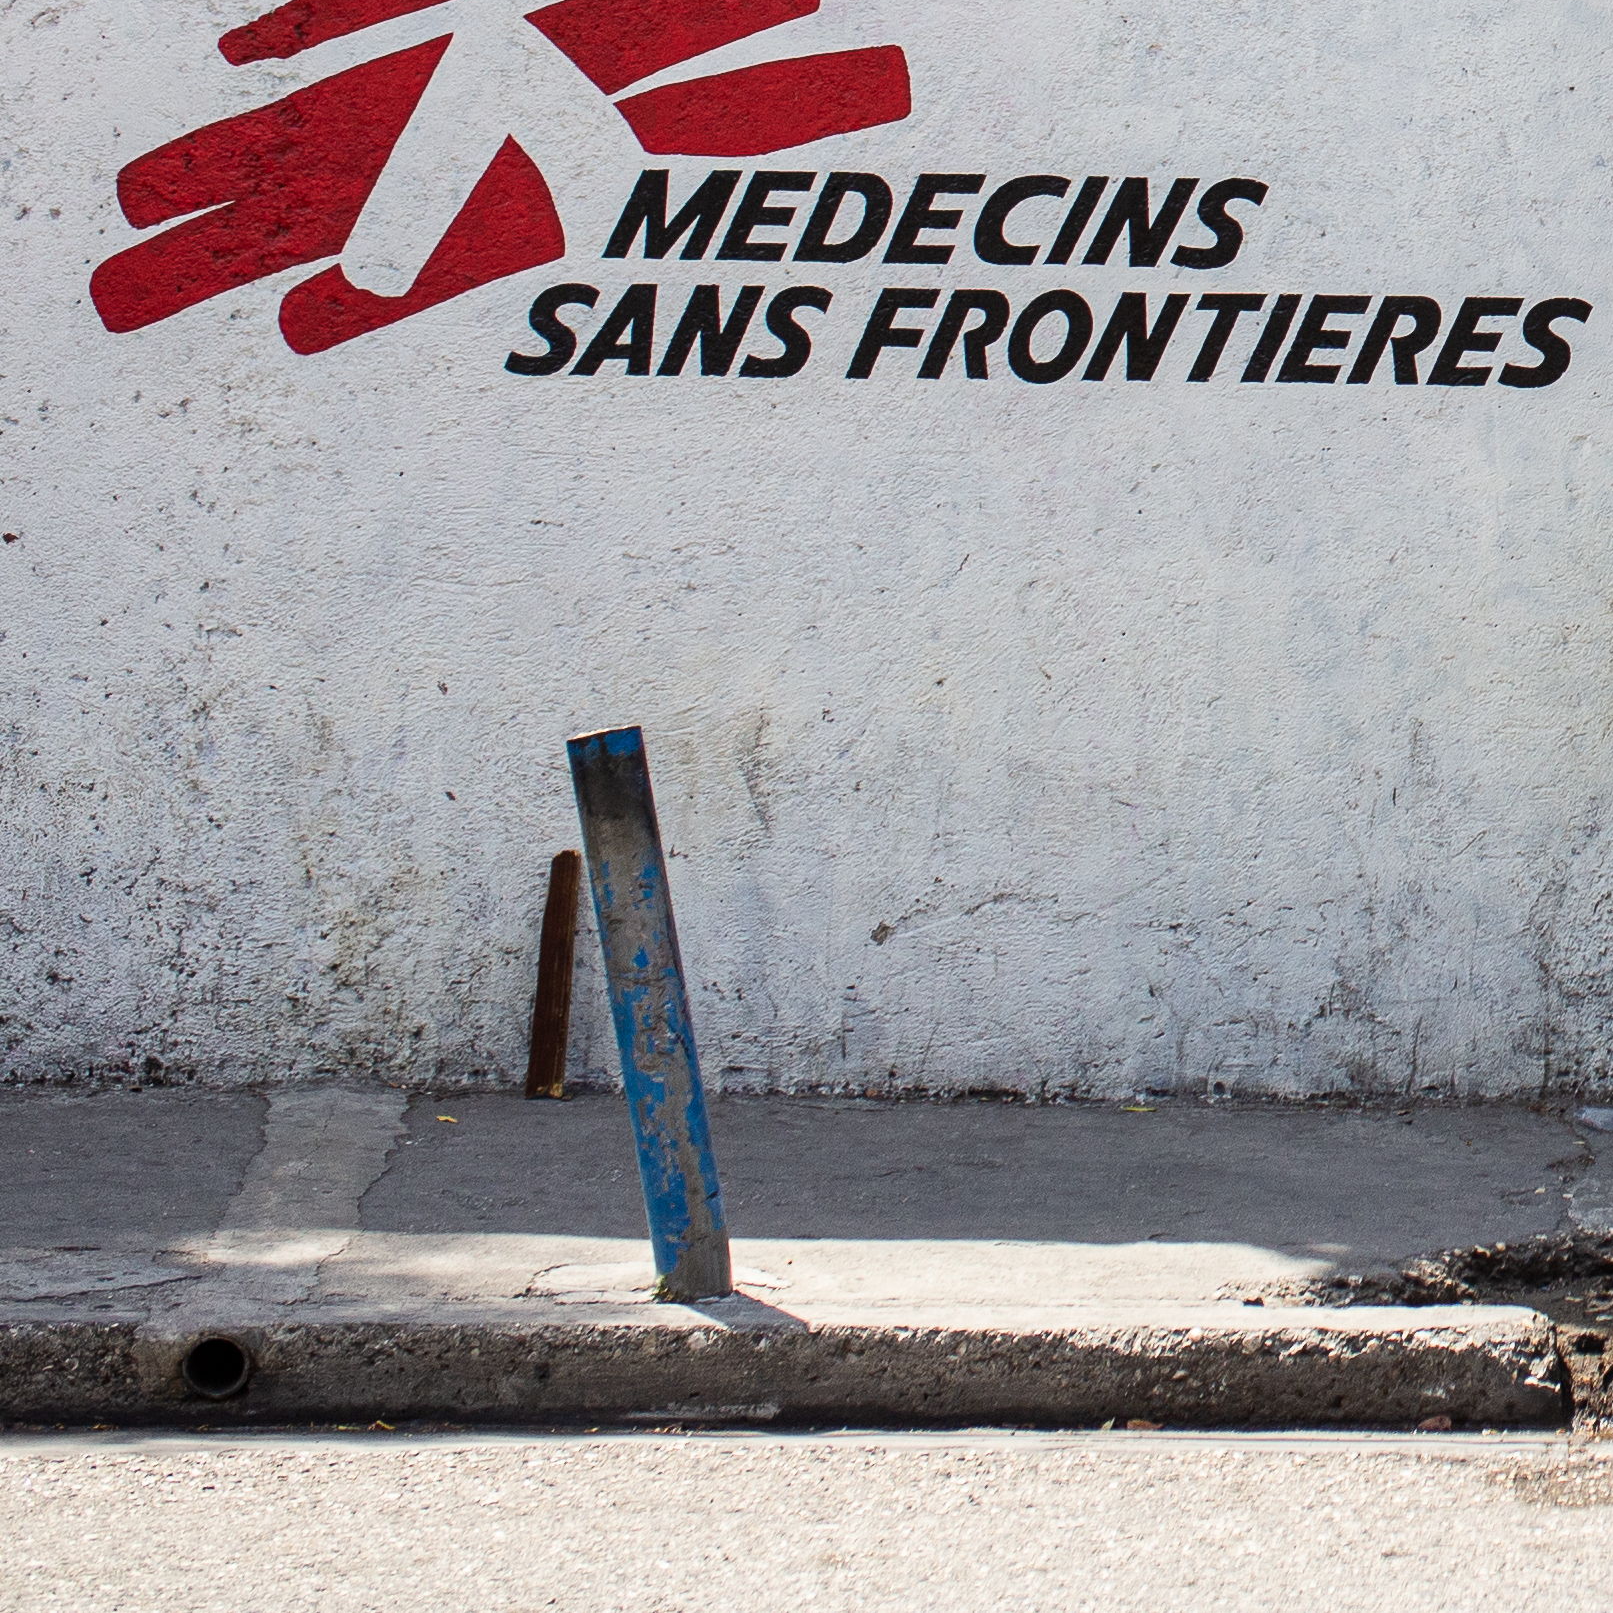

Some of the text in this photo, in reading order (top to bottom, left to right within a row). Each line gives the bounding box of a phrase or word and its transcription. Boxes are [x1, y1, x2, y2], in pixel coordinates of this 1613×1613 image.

[602, 169, 1269, 270] MEDECINS
[504, 283, 1594, 389] SANS FRONTIERES
